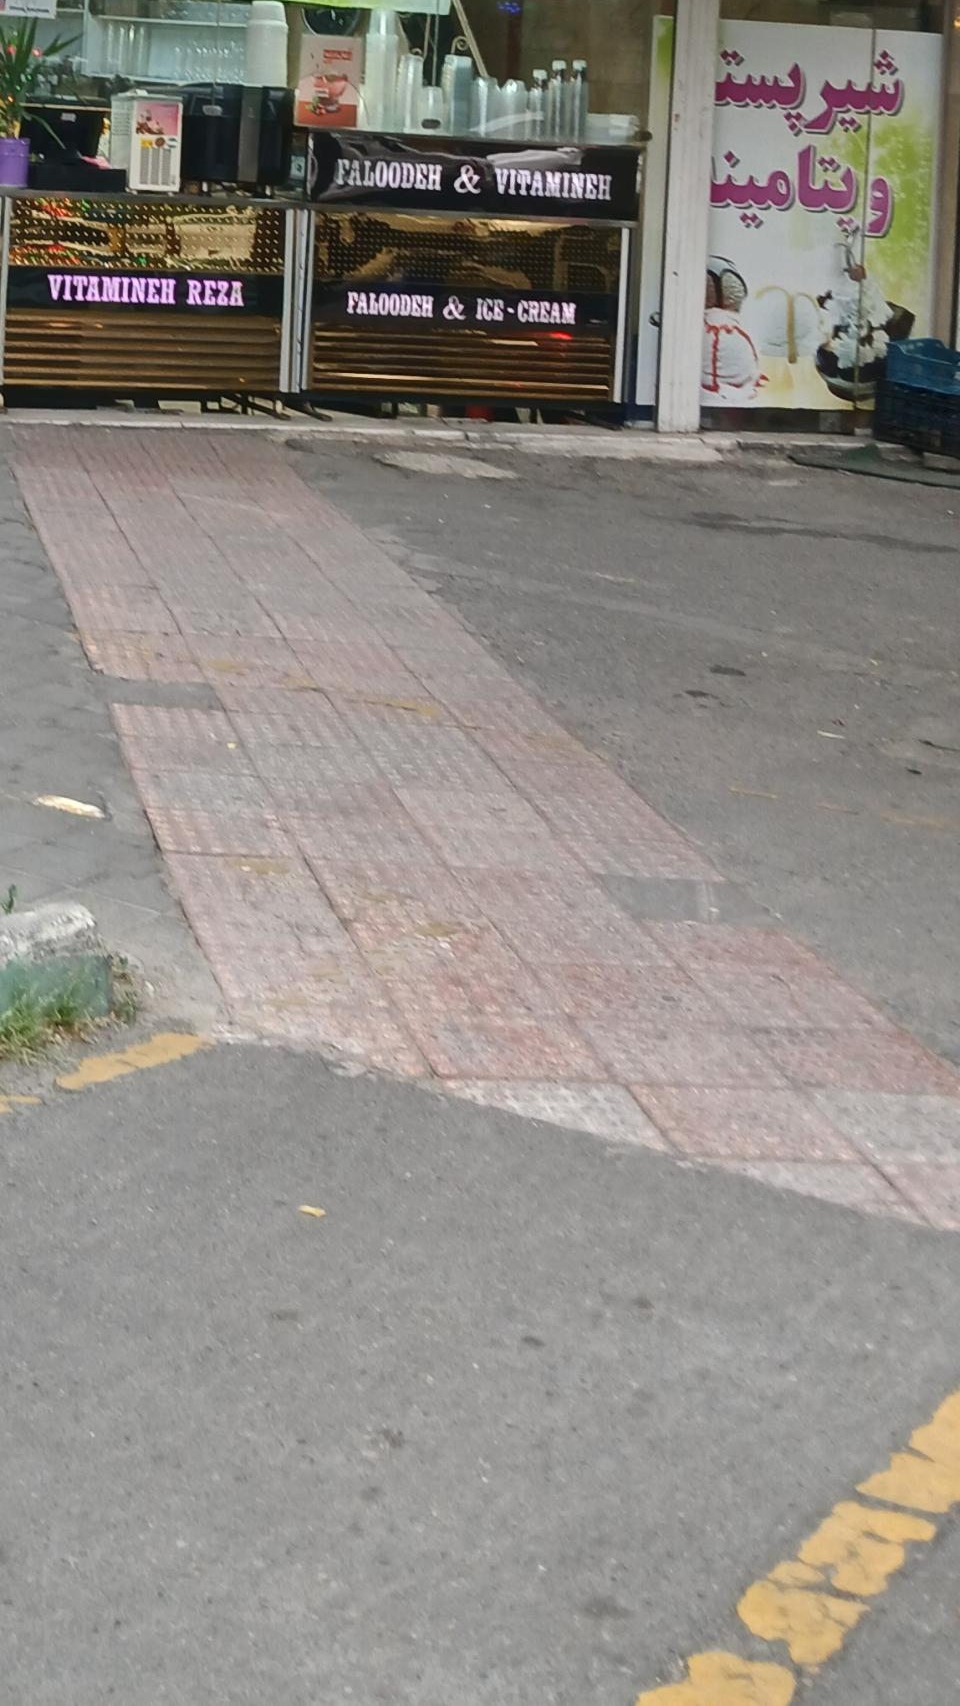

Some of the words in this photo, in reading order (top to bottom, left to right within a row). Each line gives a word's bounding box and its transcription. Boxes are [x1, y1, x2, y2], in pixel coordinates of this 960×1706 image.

[334, 157, 443, 191] FALOODEH
[453, 163, 481, 194] &
[494, 166, 613, 201] VITAMINEH
[710, 143, 894, 238] ویتامین
[47, 274, 177, 305] VITAMINEH
[186, 279, 245, 307] REZA
[346, 291, 435, 318] FALOODEH
[442, 295, 467, 321] &
